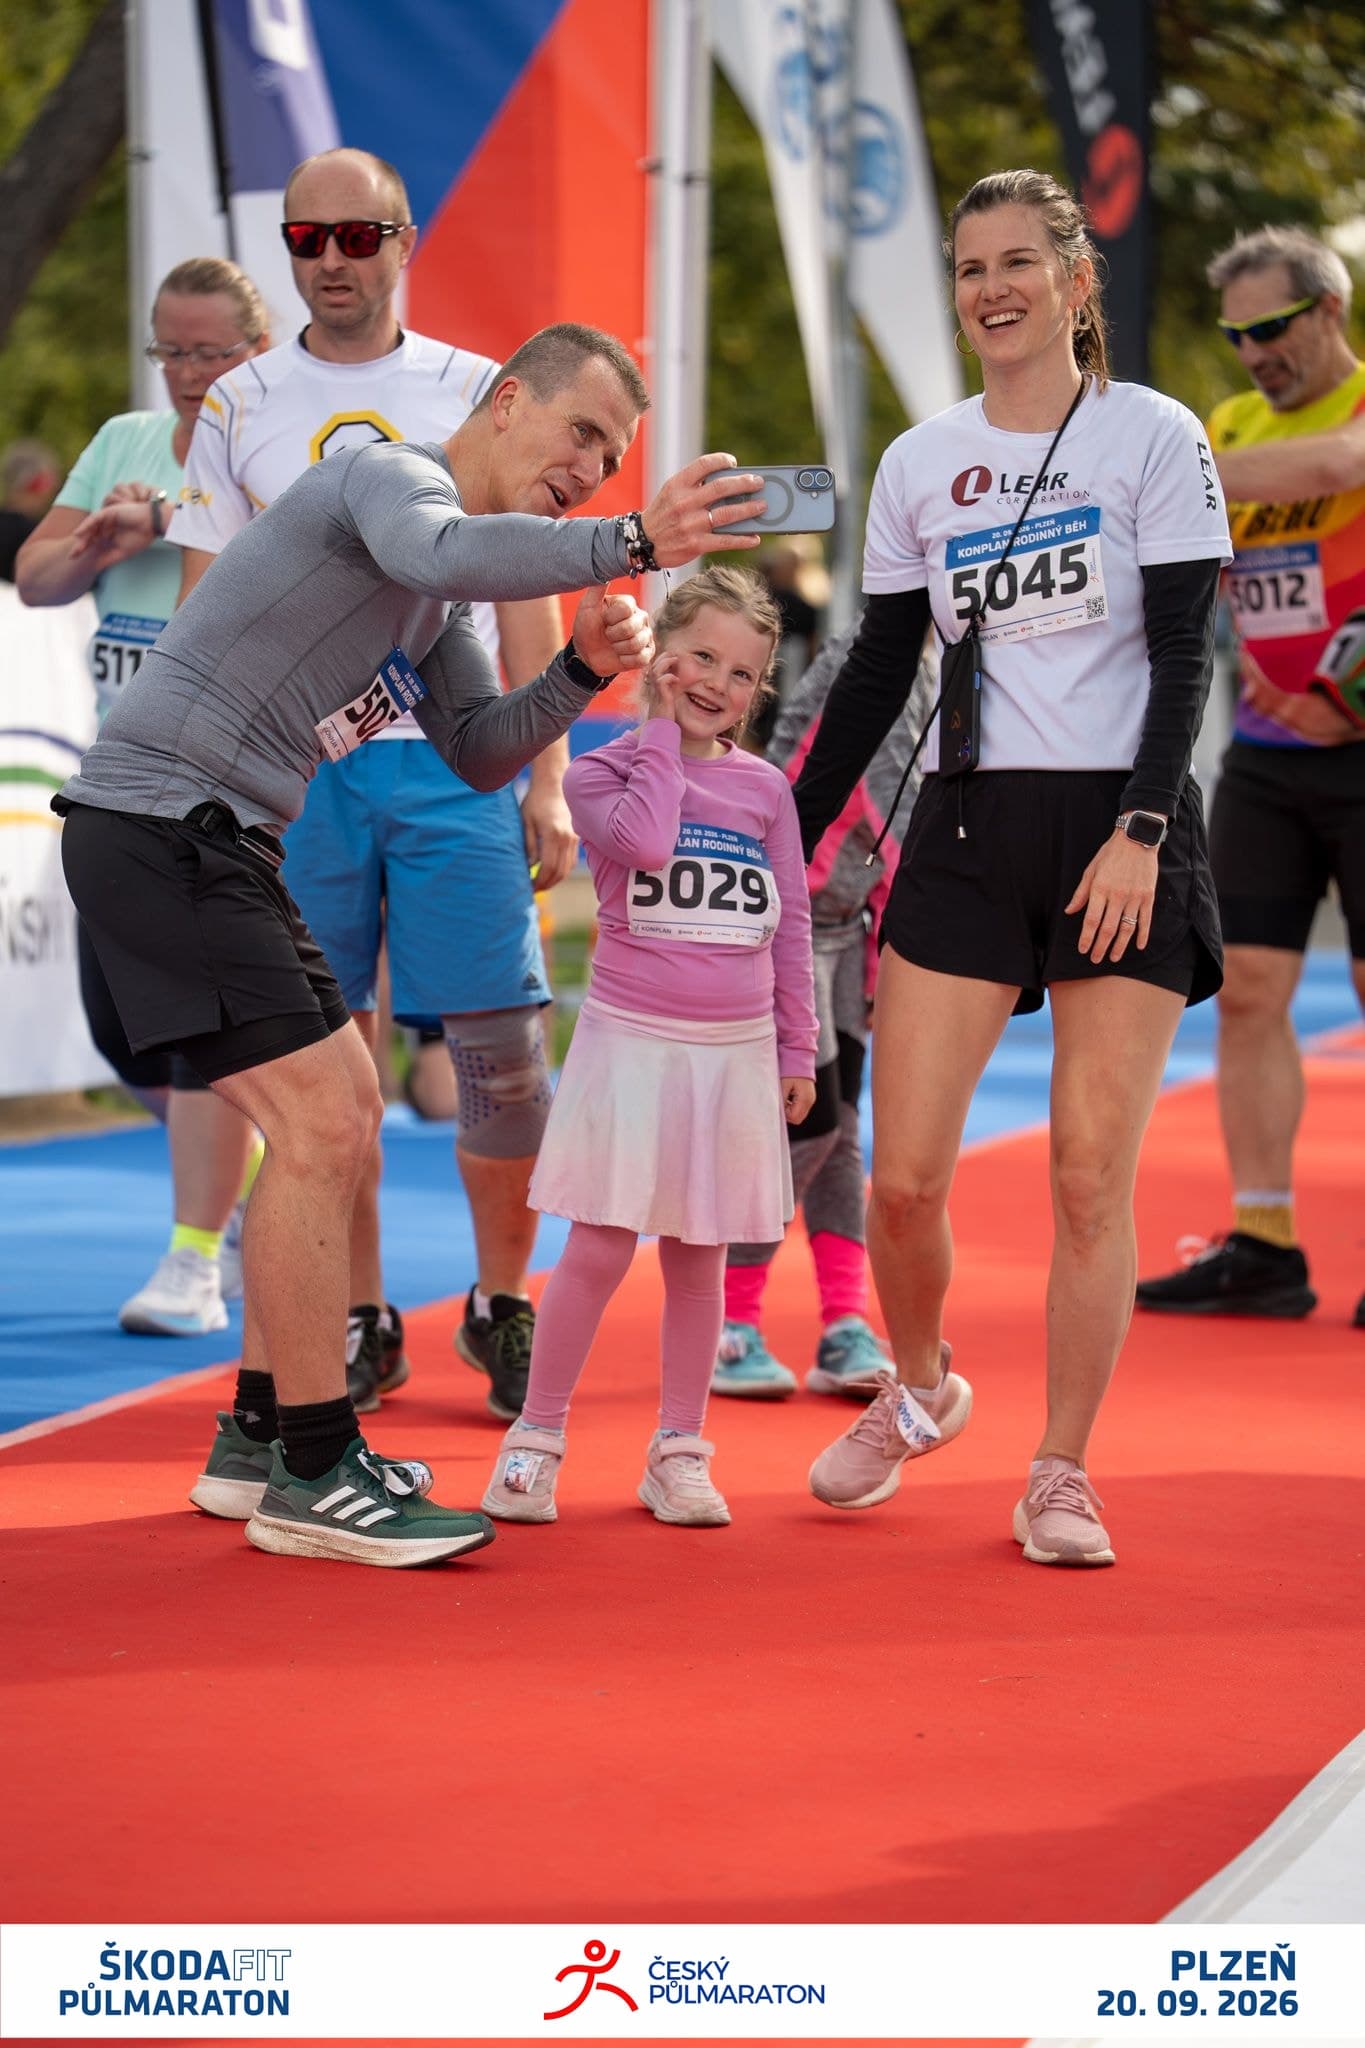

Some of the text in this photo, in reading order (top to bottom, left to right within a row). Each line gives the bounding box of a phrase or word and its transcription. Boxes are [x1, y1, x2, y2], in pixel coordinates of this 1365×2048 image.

[1000, 472, 1069, 495] LEAR
[1197, 441, 1217, 511] LEAR
[957, 520, 1087, 559] KONPLAN RODINNÝ BĚH
[952, 542, 1088, 620] 5045
[703, 838, 744, 855] RODINNÝ
[632, 860, 769, 915] 5029
